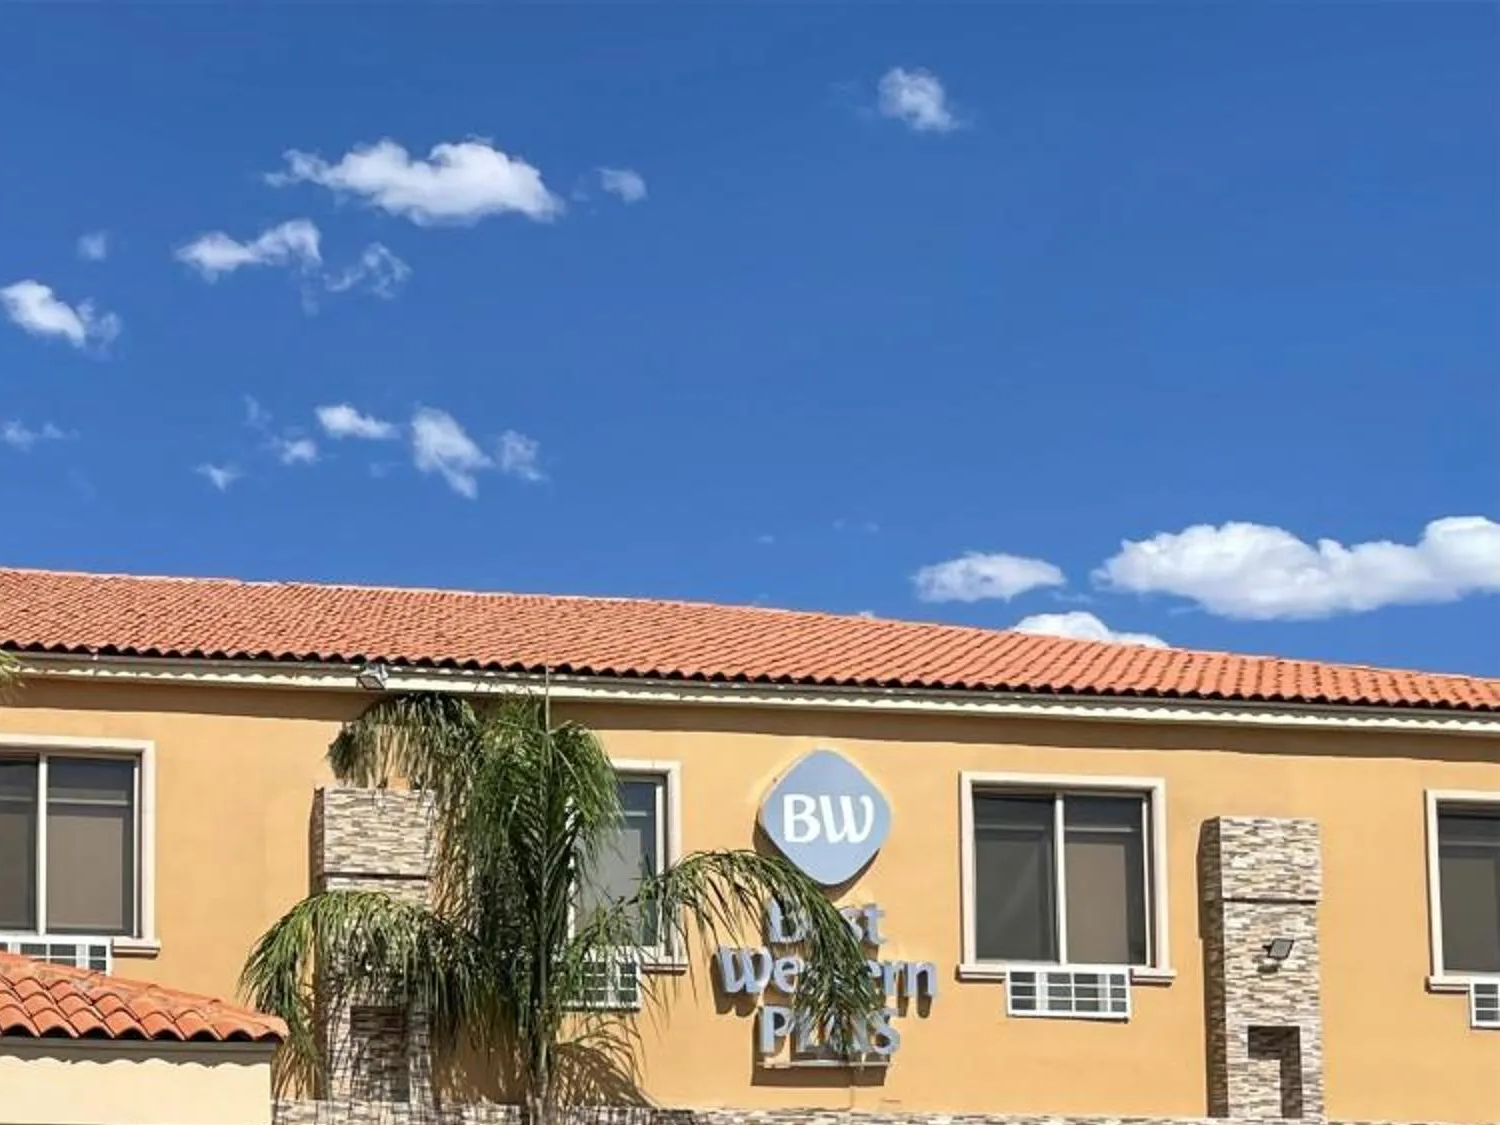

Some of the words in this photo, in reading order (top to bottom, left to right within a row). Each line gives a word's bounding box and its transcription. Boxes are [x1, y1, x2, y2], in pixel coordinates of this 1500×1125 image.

[782, 793, 875, 844] BW
[769, 898, 887, 945] Bst
[719, 946, 938, 998] Wern
